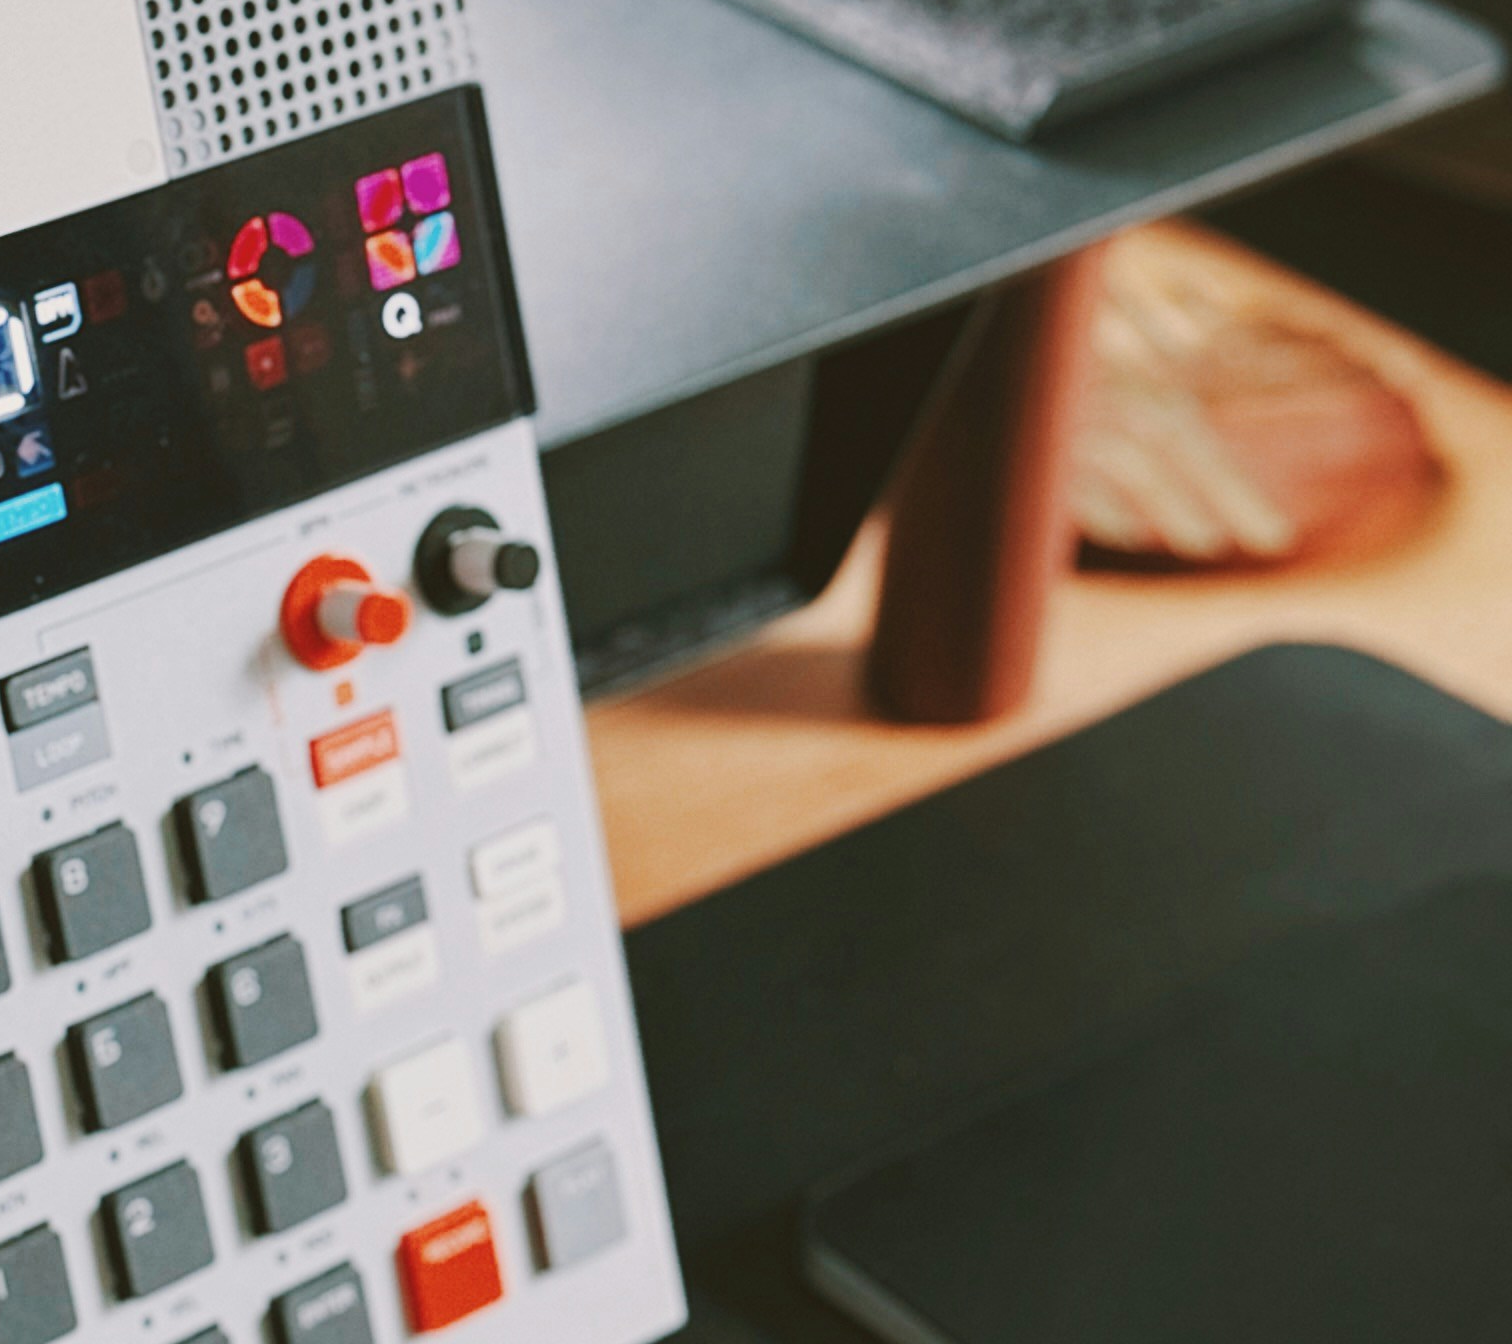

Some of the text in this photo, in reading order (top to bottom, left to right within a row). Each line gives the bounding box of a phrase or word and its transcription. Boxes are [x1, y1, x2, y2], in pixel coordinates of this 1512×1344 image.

[22, 670, 88, 710] TEMPO
[199, 799, 227, 838] 9
[59, 858, 89, 896] 8
[124, 1197, 156, 1237] 2
